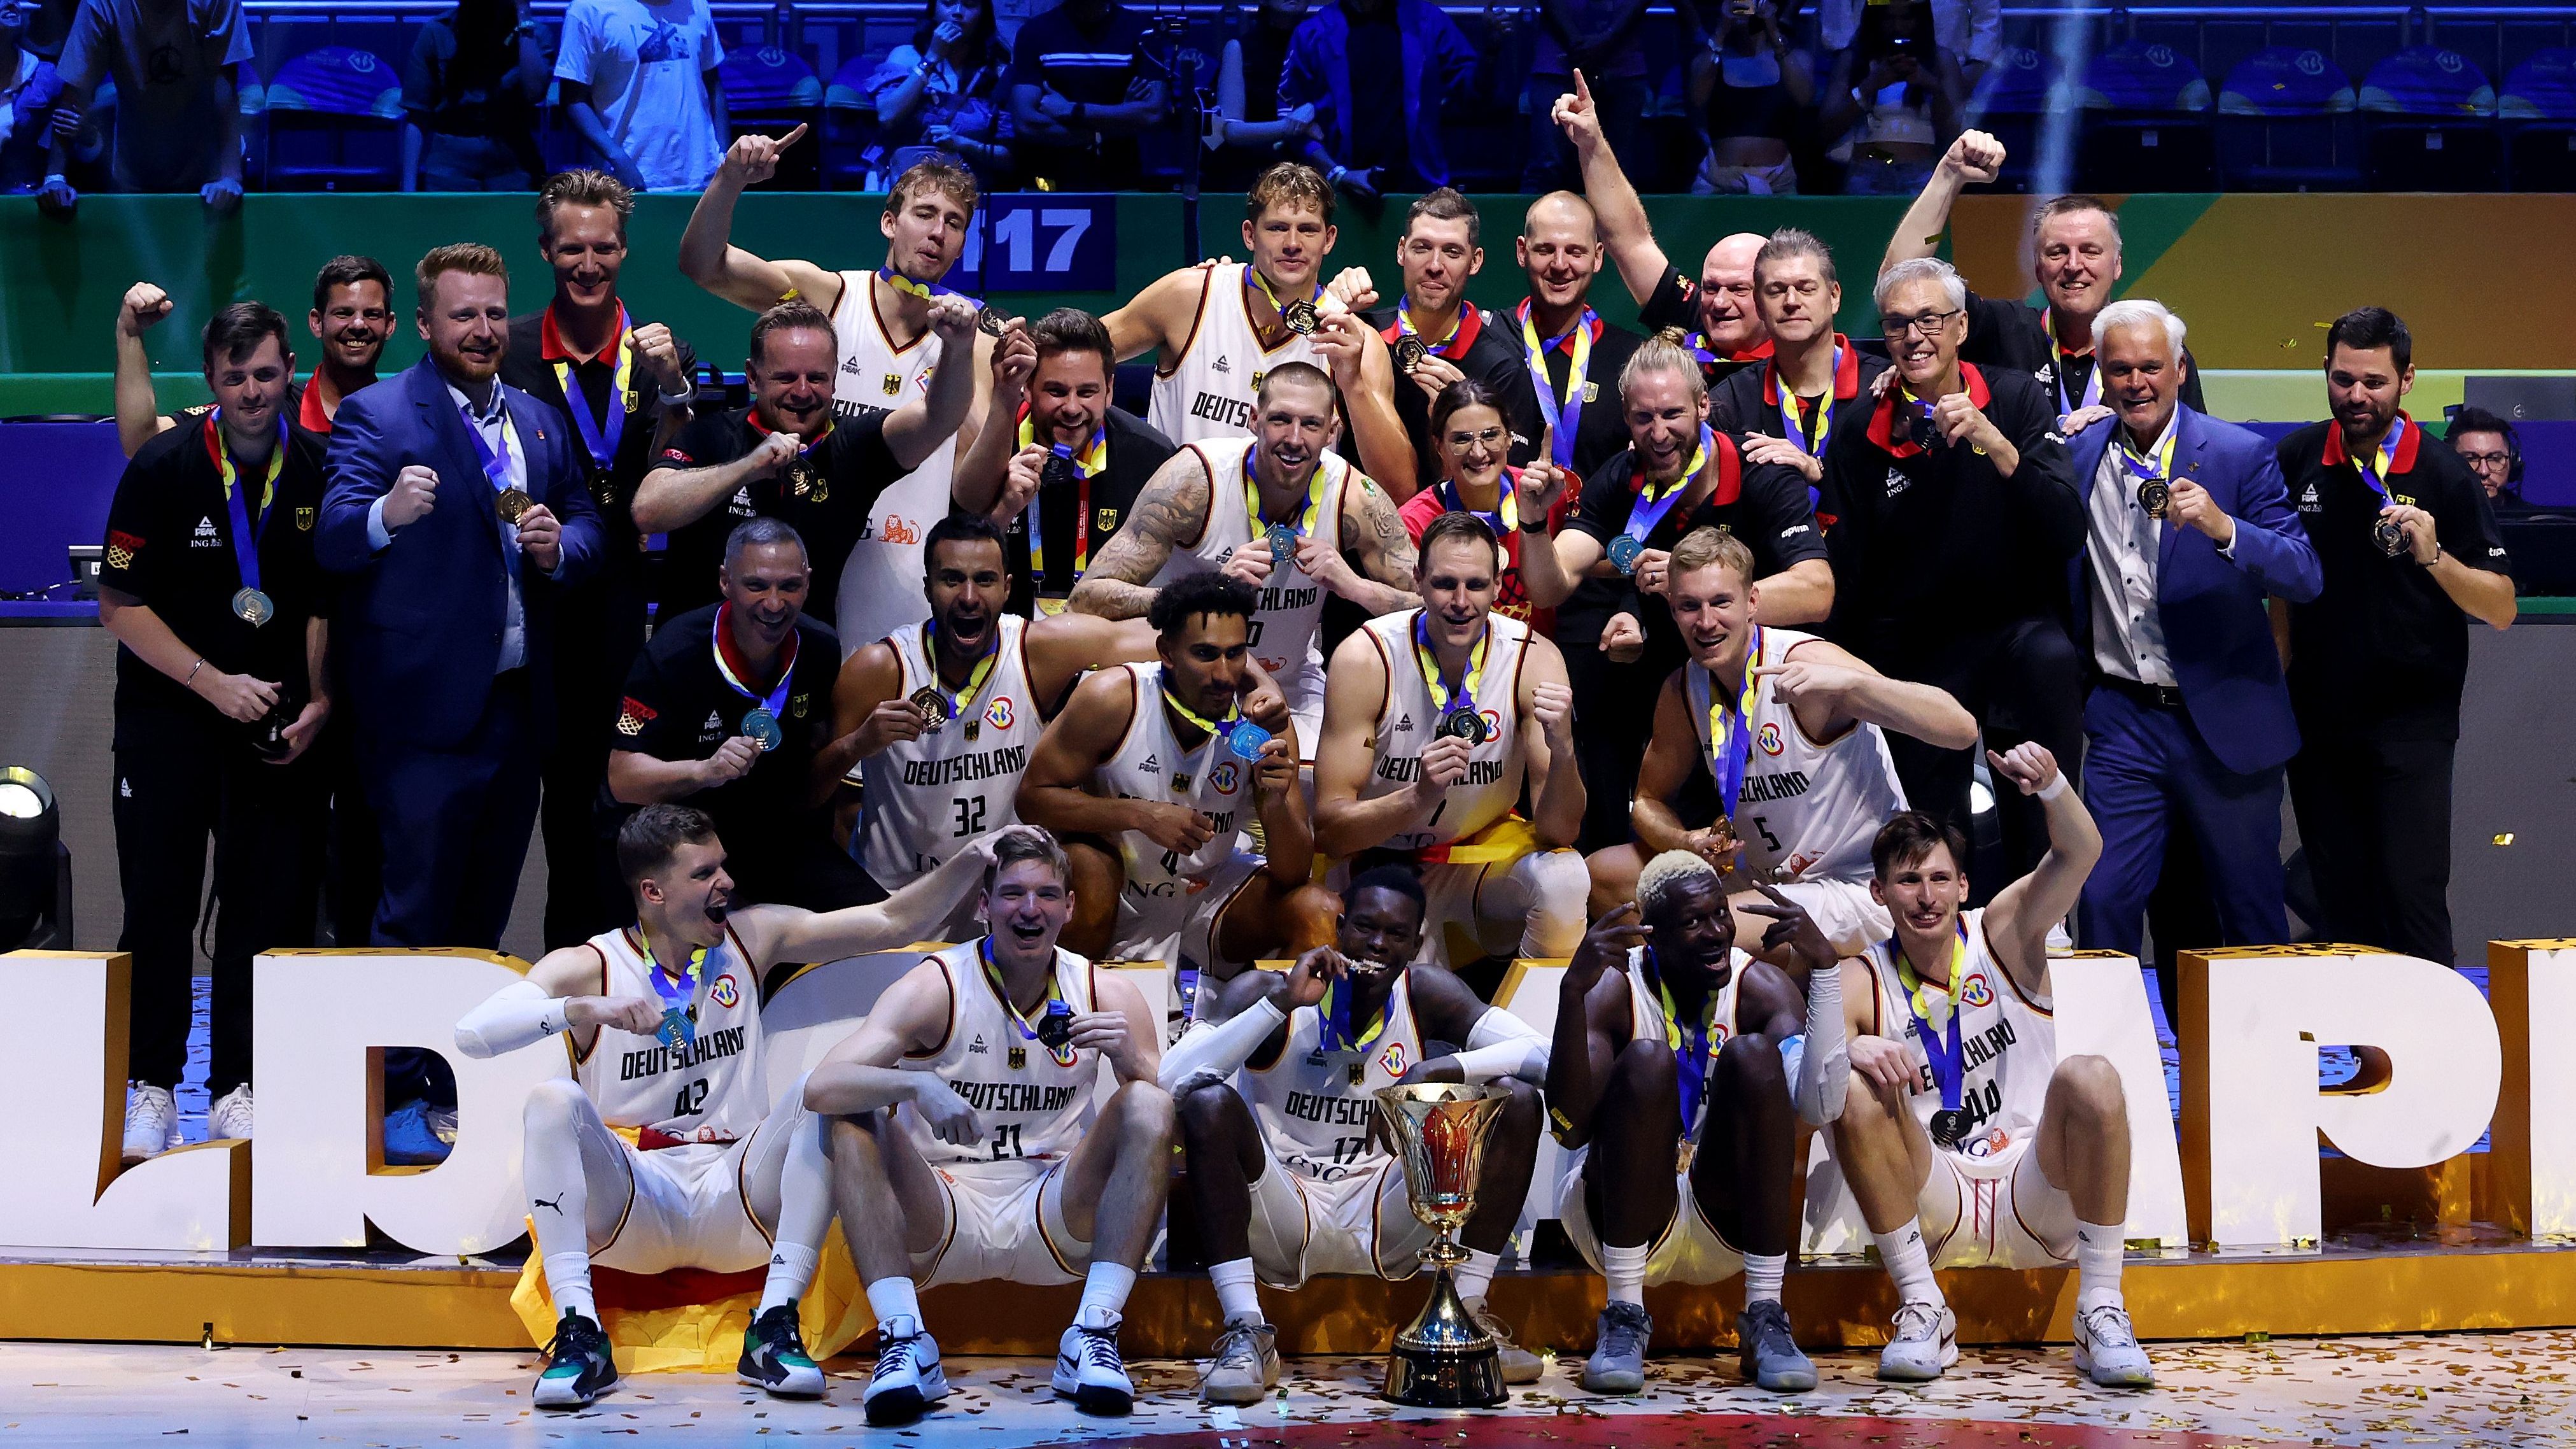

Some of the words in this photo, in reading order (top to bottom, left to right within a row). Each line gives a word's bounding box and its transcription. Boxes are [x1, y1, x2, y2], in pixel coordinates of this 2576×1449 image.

[841, 364, 861, 376] PEAK
[1212, 362, 1231, 374] PEAK
[1190, 391, 1250, 429] DEUTS
[1887, 484, 1903, 497] ING
[2301, 494, 2319, 502] PEAK
[728, 505, 744, 516] ING
[733, 495, 752, 507] PEAK
[195, 527, 218, 536] PEAK
[190, 539, 209, 548] ING
[1258, 586, 1318, 611] HLAND
[1395, 723, 1414, 732] PEAK
[699, 733, 715, 743] ING
[903, 744, 1027, 786] DEUTSCHLAND
[1137, 763, 1161, 774] PEAK
[953, 795, 987, 838] 32
[1752, 817, 1782, 852] 5
[620, 1026, 745, 1081] DEUTSCHLAND
[968, 1043, 989, 1054] PEAK
[673, 1078, 709, 1118] 42
[949, 1079, 1077, 1112] DEUTSCHLAND
[1964, 1078, 2002, 1126] 44
[1284, 1091, 1380, 1126] DEUTSCH
[990, 1124, 1024, 1161] 21
[1333, 1137, 1367, 1165] 17
